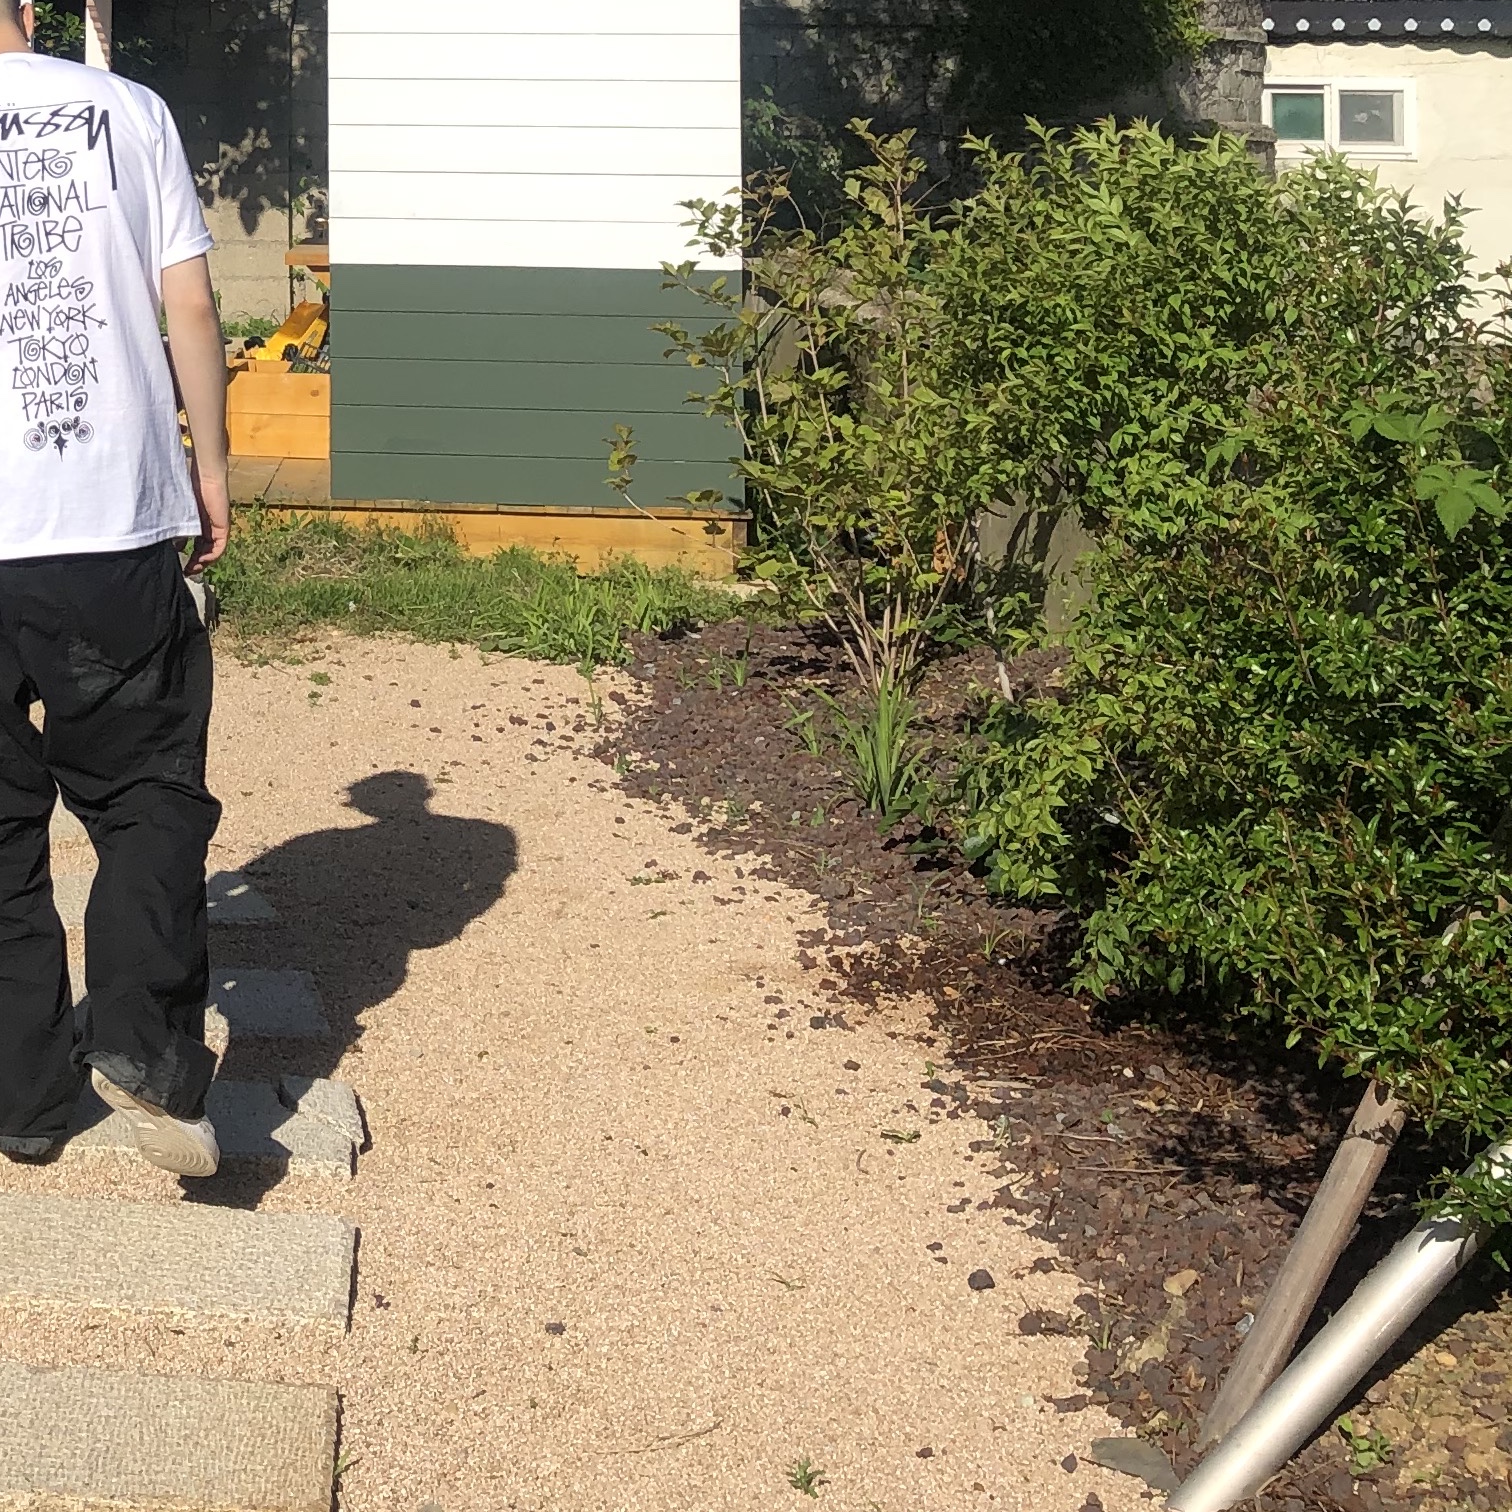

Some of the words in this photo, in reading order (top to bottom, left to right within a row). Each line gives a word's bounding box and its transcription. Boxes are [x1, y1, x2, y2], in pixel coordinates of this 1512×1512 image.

[27, 257, 63, 279] LOS
[42, 303, 107, 334] YORK
[7, 332, 89, 365] TOKYO
[12, 357, 99, 389] LONDON
[22, 386, 88, 421] PARIS
